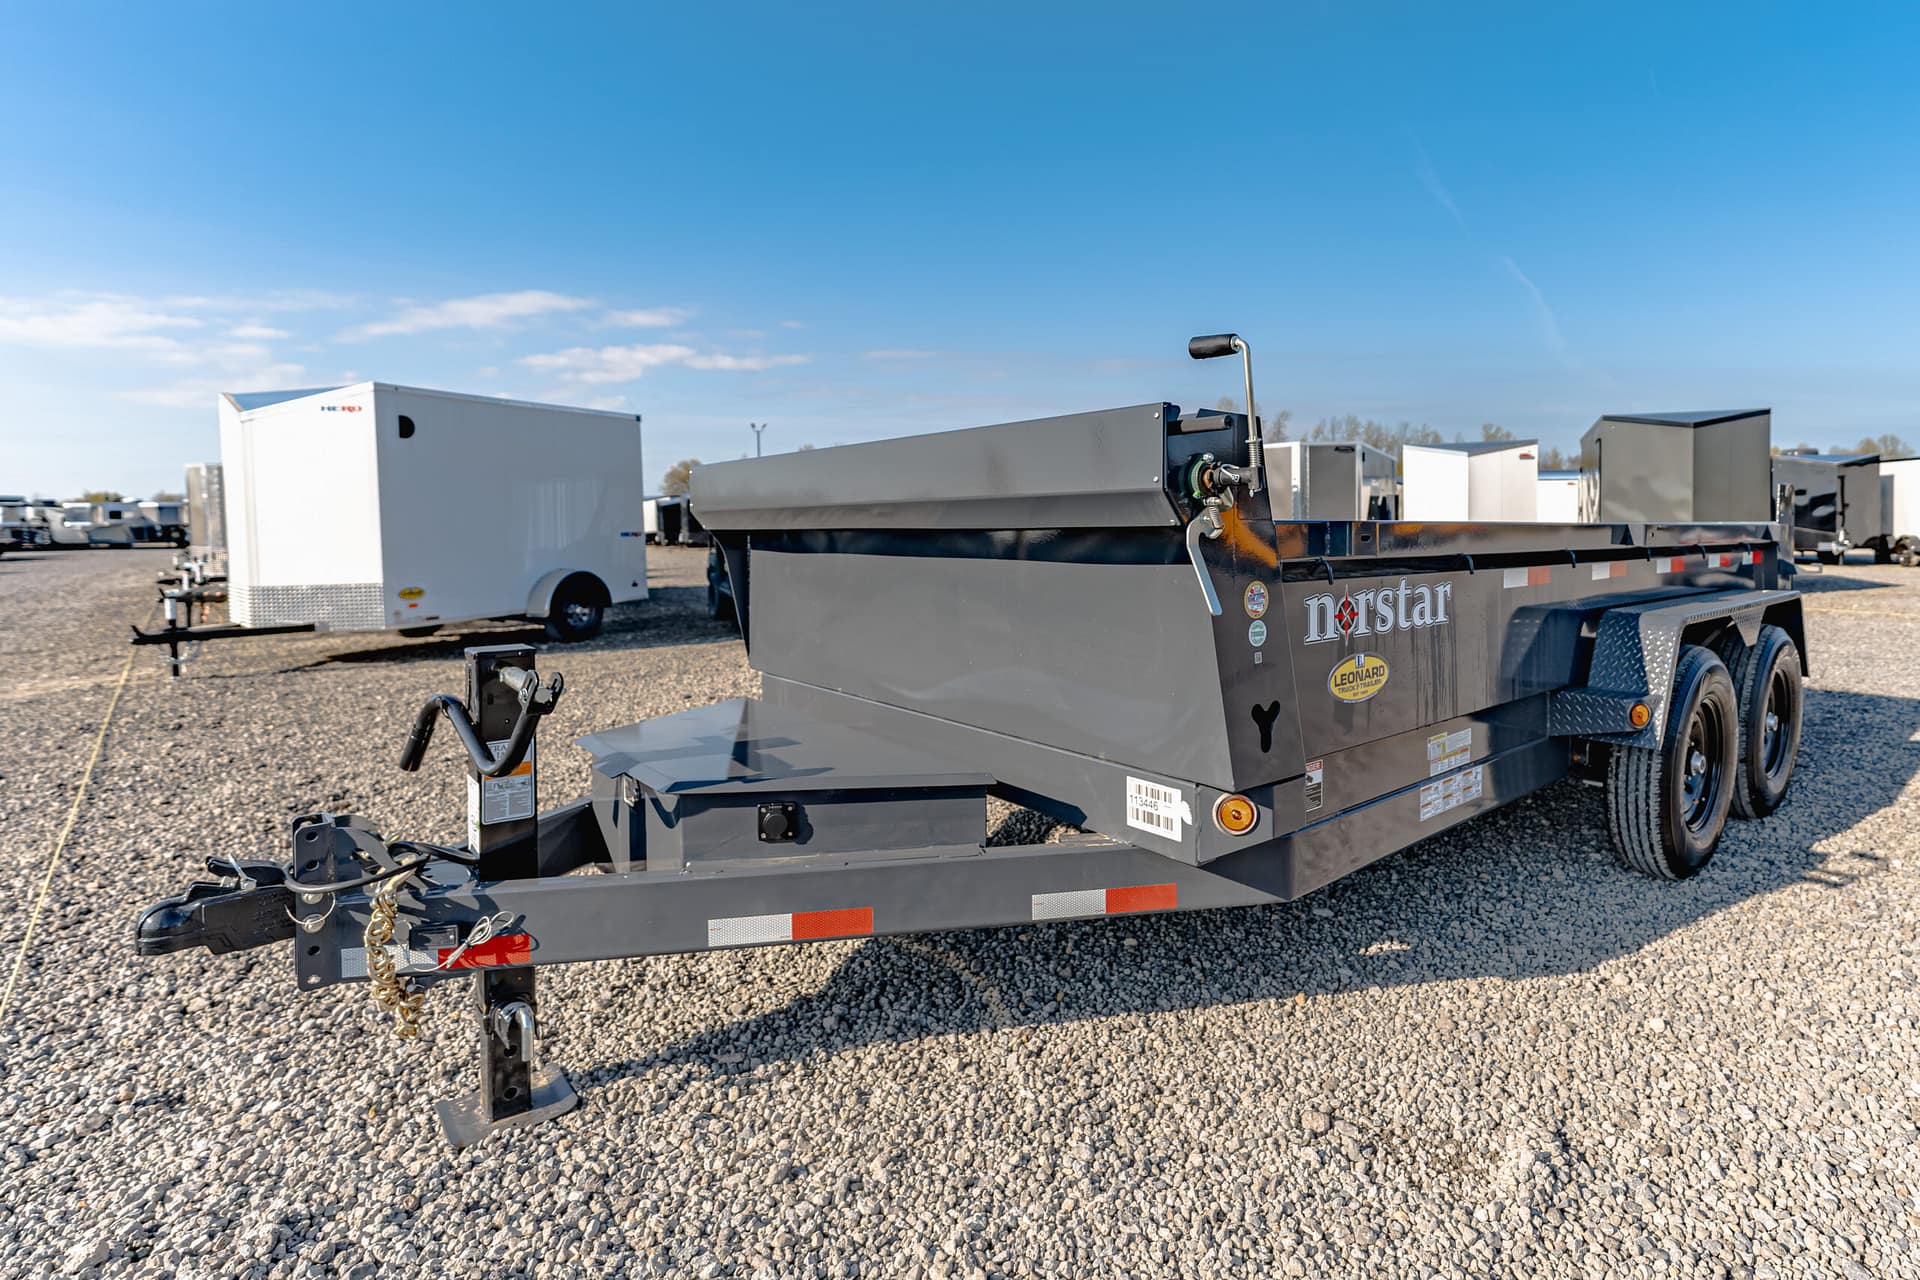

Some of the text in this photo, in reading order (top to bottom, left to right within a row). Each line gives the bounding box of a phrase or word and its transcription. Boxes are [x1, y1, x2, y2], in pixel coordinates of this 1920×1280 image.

[1304, 576, 1453, 646] norstar
[1334, 664, 1385, 687] LEONARD
[1129, 794, 1159, 811] 113446
